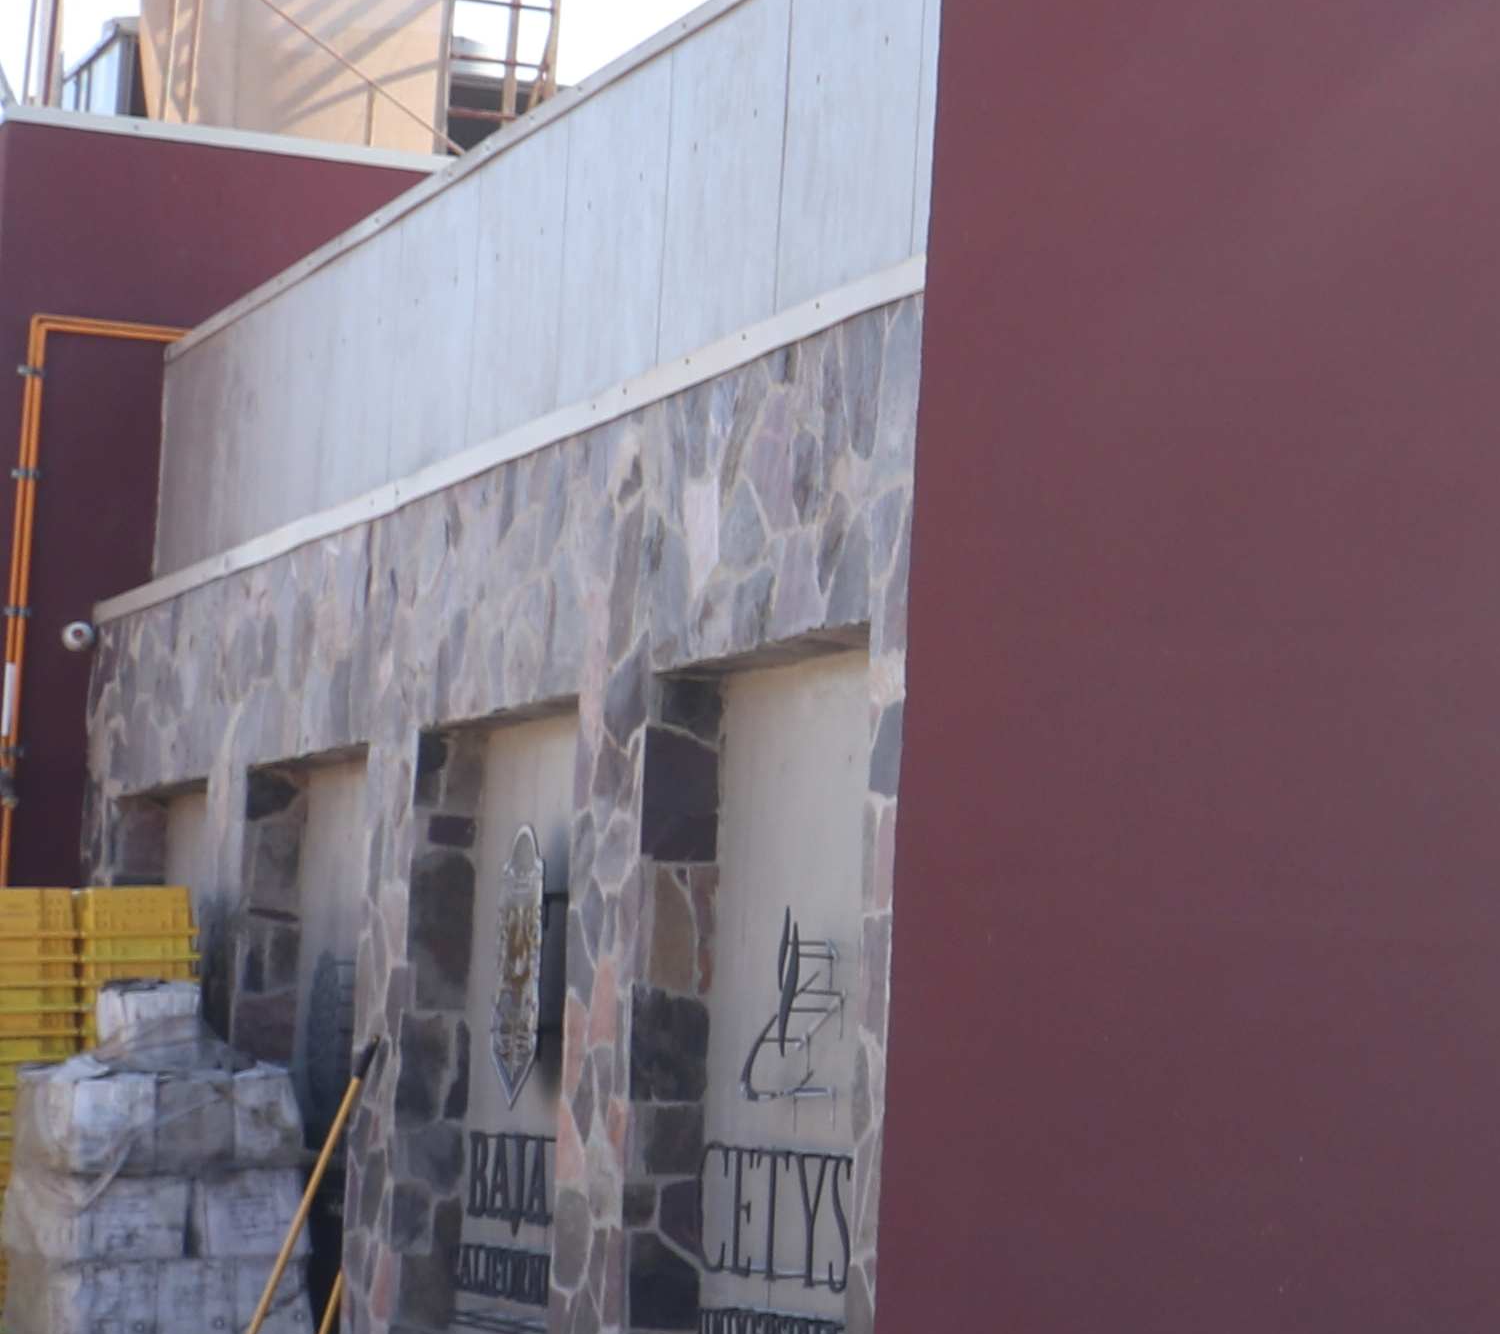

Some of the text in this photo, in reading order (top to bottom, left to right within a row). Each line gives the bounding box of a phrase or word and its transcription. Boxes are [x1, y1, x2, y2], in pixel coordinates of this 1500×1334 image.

[467, 1131, 553, 1237] BAJA
[698, 1140, 853, 1293] CETYS
[455, 1243, 550, 1307] ALIFORNI
